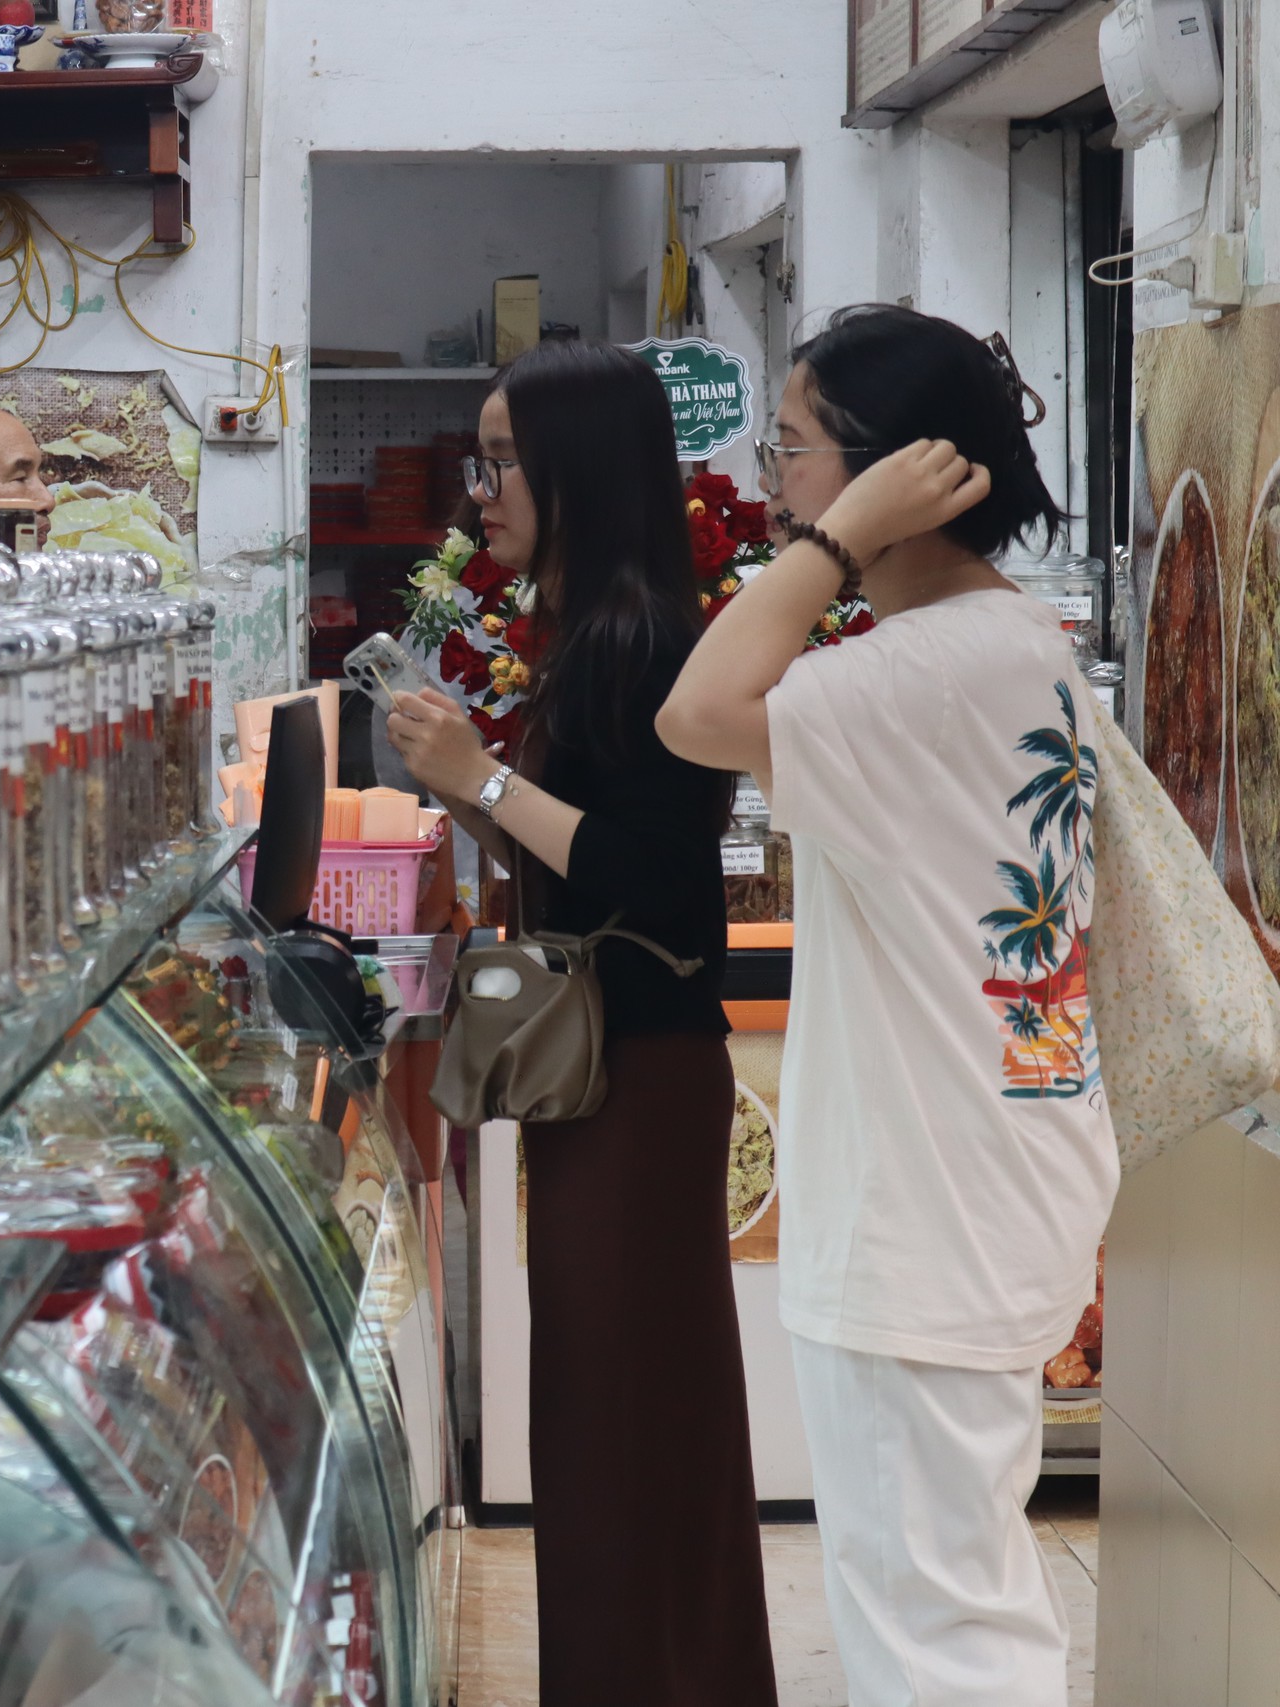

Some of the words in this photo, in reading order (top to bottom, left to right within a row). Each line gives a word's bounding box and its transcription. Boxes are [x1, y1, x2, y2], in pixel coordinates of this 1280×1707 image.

[671, 382, 691, 402] HÀ
[691, 380, 737, 401] THÀNH
[692, 402, 714, 422] Việt
[713, 400, 740, 421] Nam
